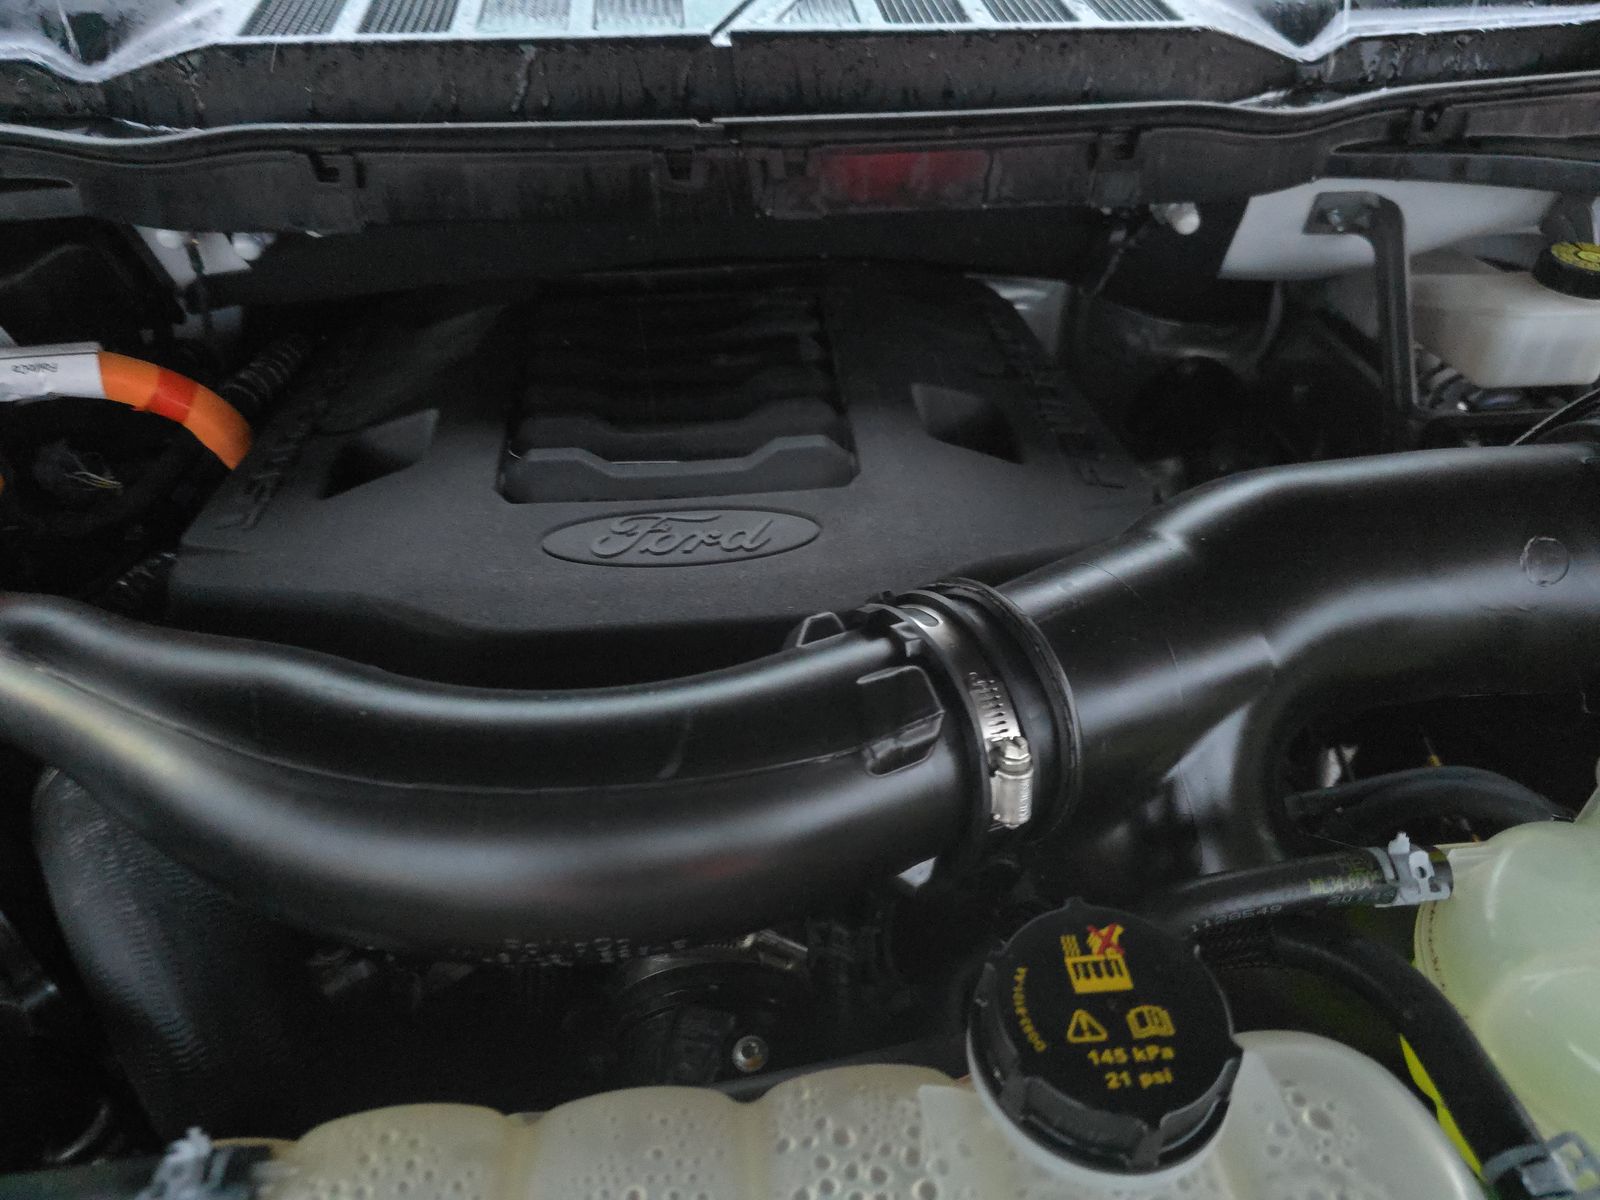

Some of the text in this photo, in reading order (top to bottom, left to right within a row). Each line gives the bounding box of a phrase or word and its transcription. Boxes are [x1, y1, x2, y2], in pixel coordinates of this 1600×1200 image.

[591, 514, 773, 559] Ford
[1087, 1044, 1175, 1067] 145 kPa
[1104, 1067, 1174, 1090] 21 psi
